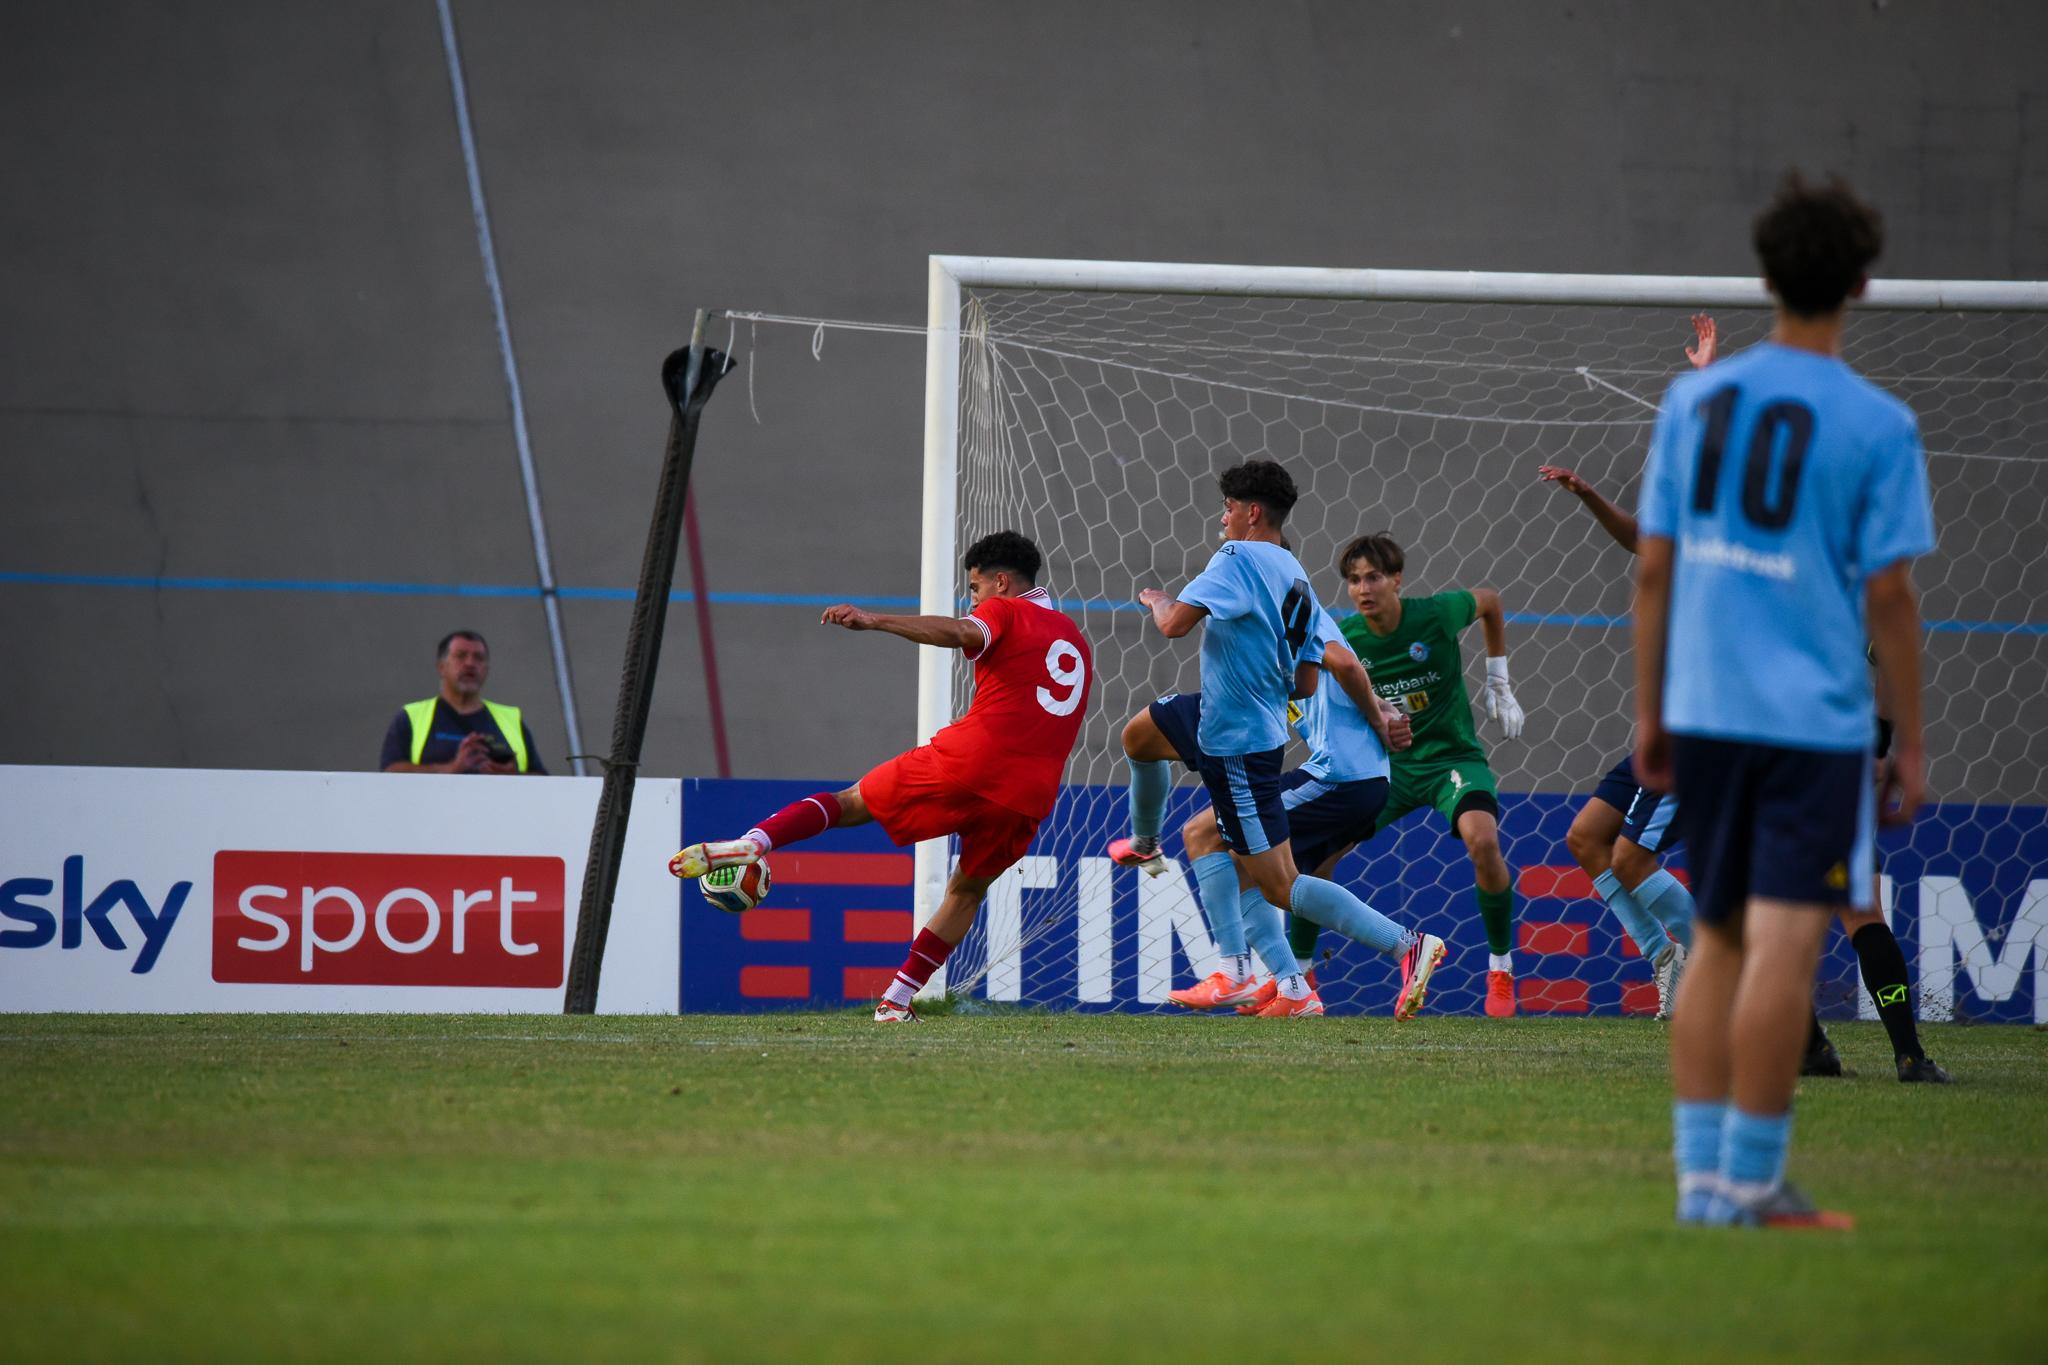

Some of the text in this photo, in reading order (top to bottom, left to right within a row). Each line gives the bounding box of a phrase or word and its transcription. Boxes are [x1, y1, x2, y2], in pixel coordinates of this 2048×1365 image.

[1692, 383, 1816, 532] 10
[1036, 638, 1087, 717] 9
[0, 854, 540, 974] sky sport
